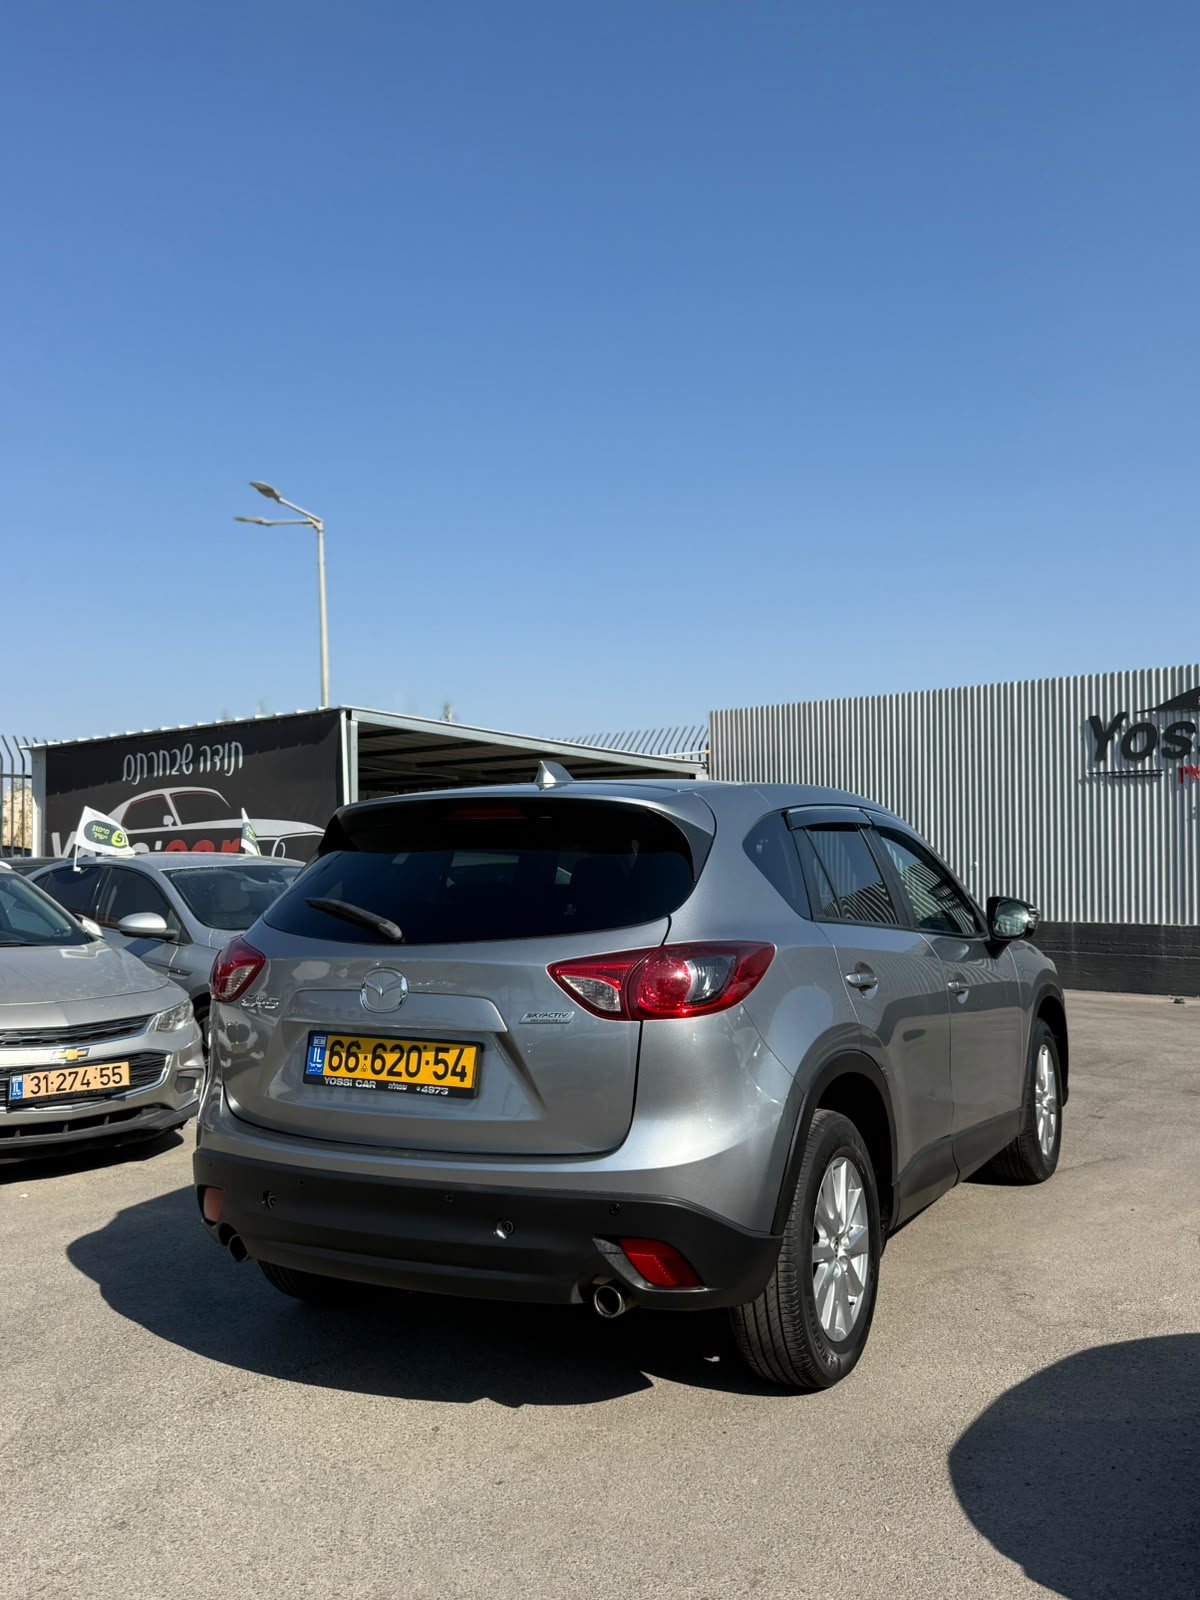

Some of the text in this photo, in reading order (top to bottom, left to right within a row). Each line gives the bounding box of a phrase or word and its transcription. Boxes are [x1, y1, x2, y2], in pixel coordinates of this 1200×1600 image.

[1088, 711, 1200, 762] Yos
[122, 741, 243, 785] תודה שבחרתם
[313, 1047, 322, 1063] IL
[324, 1077, 353, 1087] YOSSI
[355, 1079, 377, 1089] CAR
